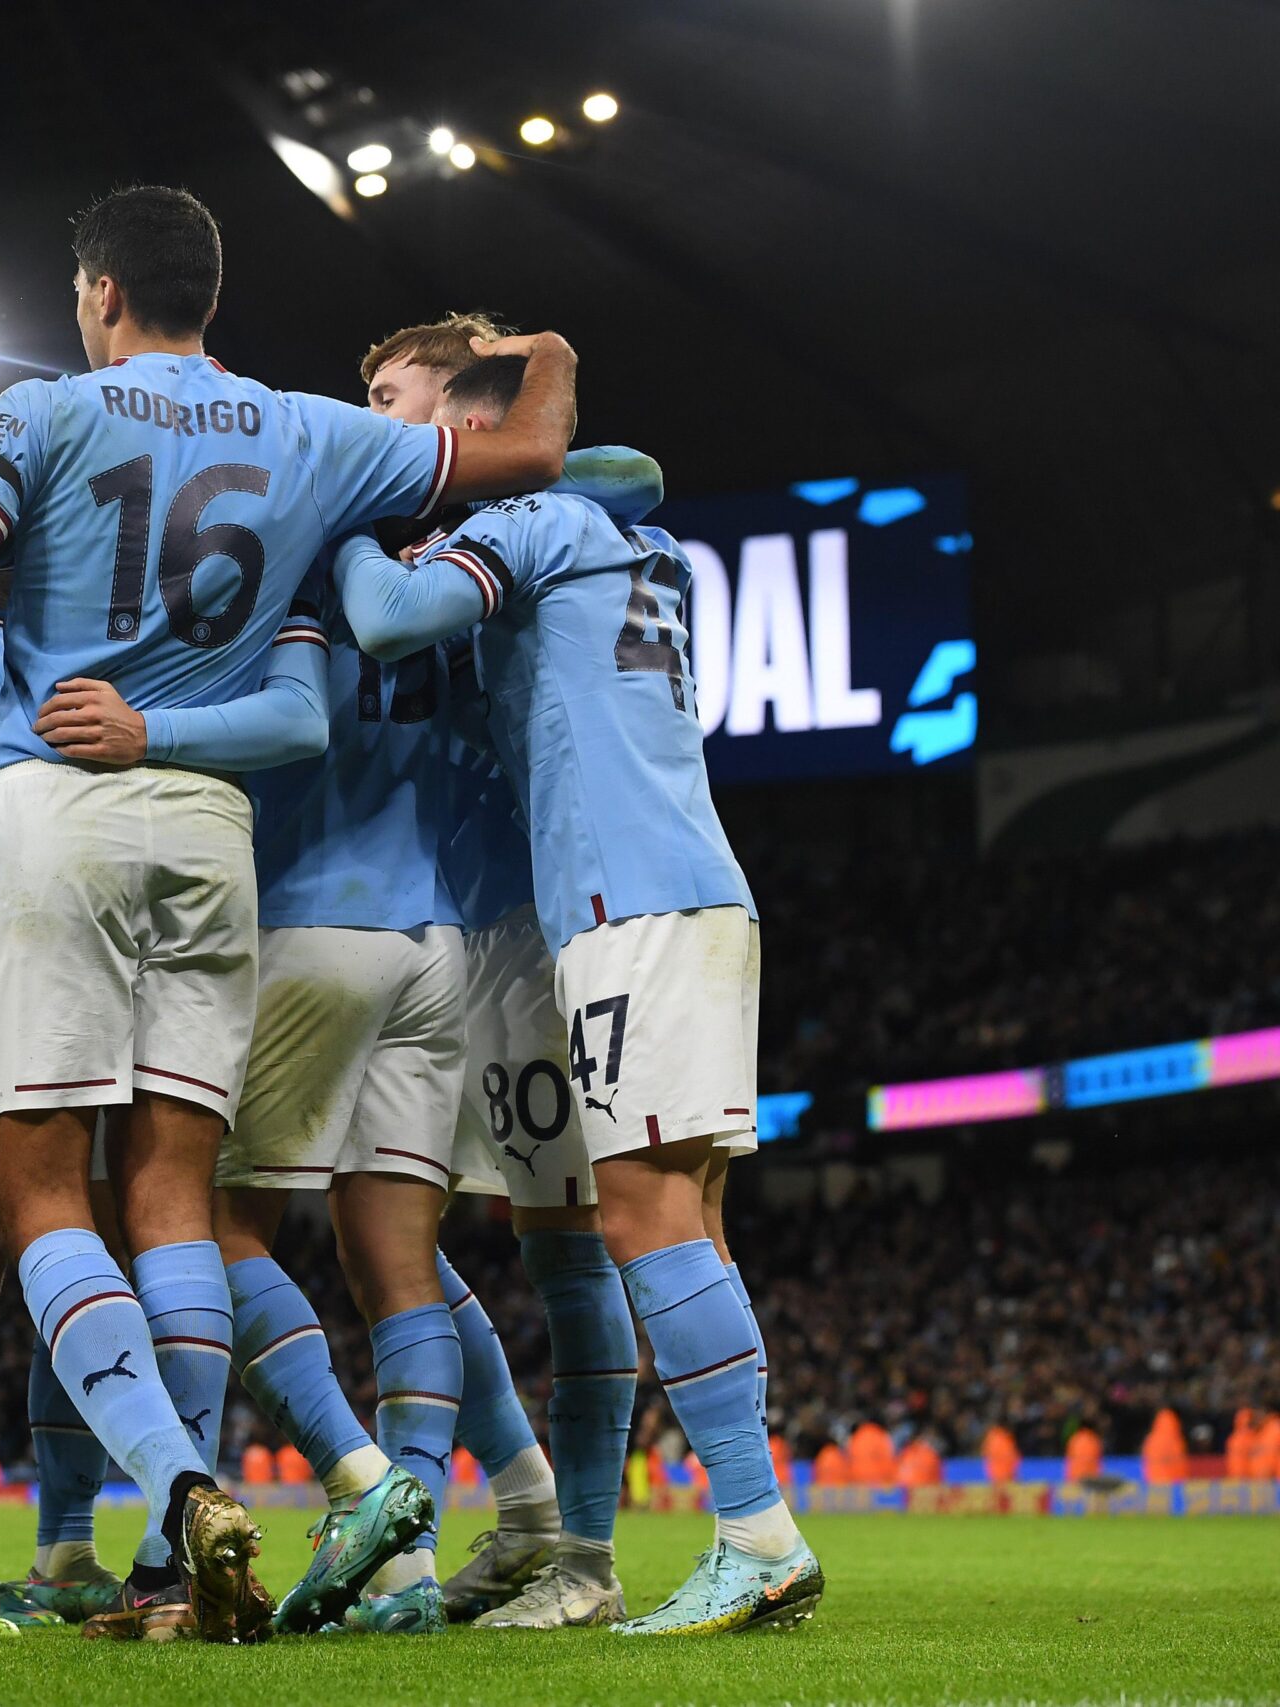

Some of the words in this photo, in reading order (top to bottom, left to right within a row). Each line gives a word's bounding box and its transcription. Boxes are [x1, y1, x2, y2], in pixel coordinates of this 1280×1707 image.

[100, 384, 262, 438] RODRIGO
[87, 453, 271, 649] 16
[570, 993, 630, 1094] 47
[482, 1058, 571, 1144] 80
